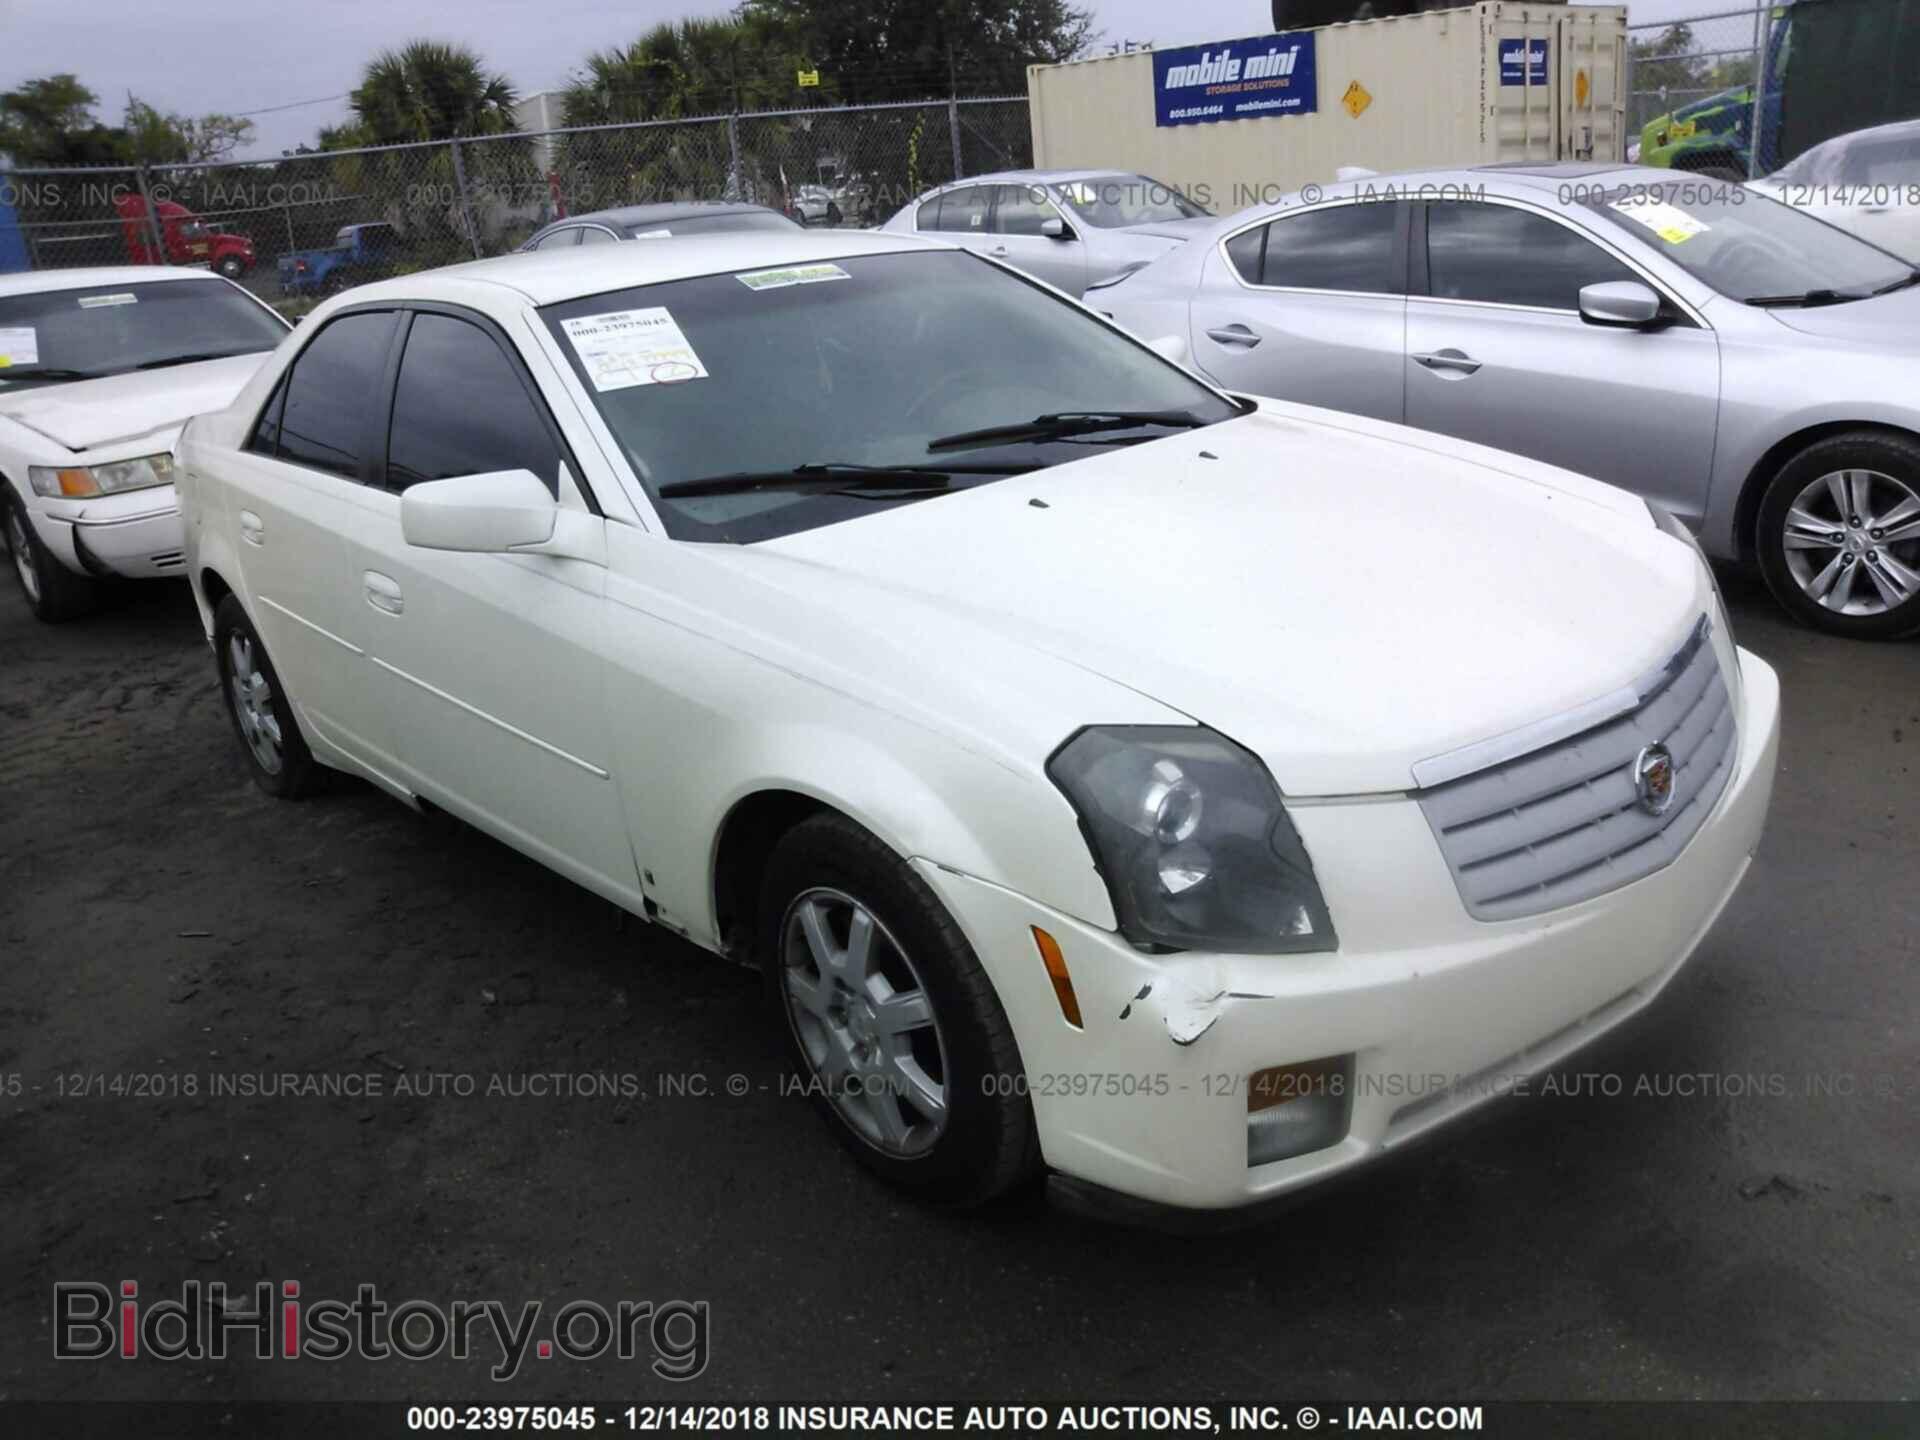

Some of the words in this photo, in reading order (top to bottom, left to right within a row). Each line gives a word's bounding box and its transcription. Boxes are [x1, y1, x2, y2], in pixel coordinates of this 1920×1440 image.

[1165, 49, 1241, 89] mobile
[1243, 45, 1299, 79] mini
[1206, 83, 1241, 96] STORAGE
[1243, 78, 1290, 91] SOLUTIONS
[1235, 98, 1301, 112] mobilemini.com
